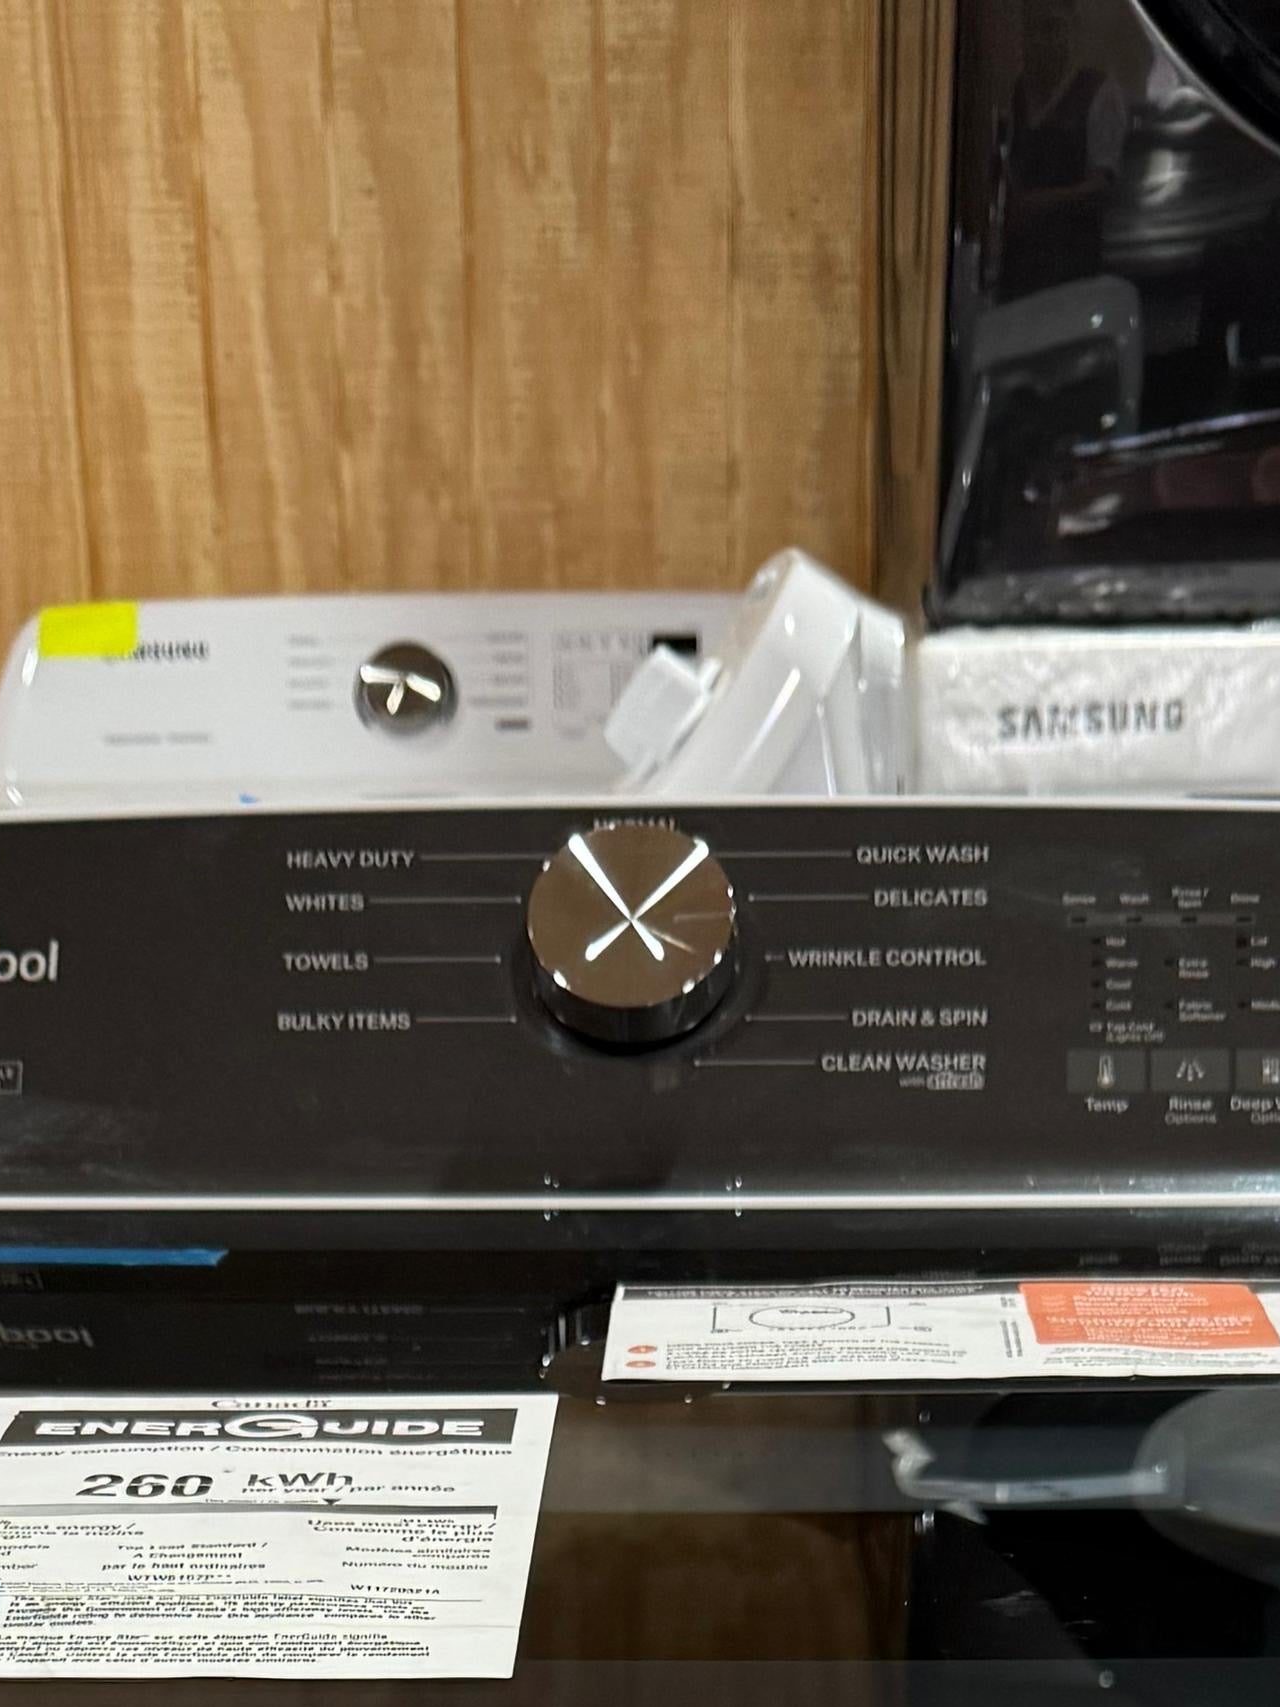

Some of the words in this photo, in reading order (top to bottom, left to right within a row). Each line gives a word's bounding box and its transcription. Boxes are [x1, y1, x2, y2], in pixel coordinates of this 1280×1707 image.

[997, 700, 1185, 740] SAMSUNG
[287, 850, 356, 868] HEAVY
[359, 849, 415, 867] DUTY
[856, 846, 921, 864] QUICK
[925, 845, 990, 863] WASH
[286, 894, 365, 911] WHITES
[873, 889, 989, 907] DELICATES
[282, 952, 369, 971] TOWELS
[787, 949, 882, 967] WRINKLE
[885, 948, 988, 966] CONTROL
[1250, 957, 1277, 970] High
[277, 1013, 344, 1031] BULKY
[348, 1012, 411, 1030] ITEMS
[851, 1009, 918, 1027] DRAIN
[920, 1010, 936, 1027] &
[938, 1009, 989, 1027] SPIN
[821, 1053, 892, 1072] CLEAN
[895, 1053, 987, 1072] WASHER
[1084, 1097, 1129, 1114] Temp
[1168, 1097, 1213, 1111] Rinse
[1230, 1097, 1276, 1113] Deep
[34, 1413, 485, 1440] ENERGUIDE
[70, 1445, 204, 1455] consumption
[225, 1445, 383, 1455] Consommation
[74, 1473, 215, 1498] 260
[246, 1471, 354, 1487] kWh
